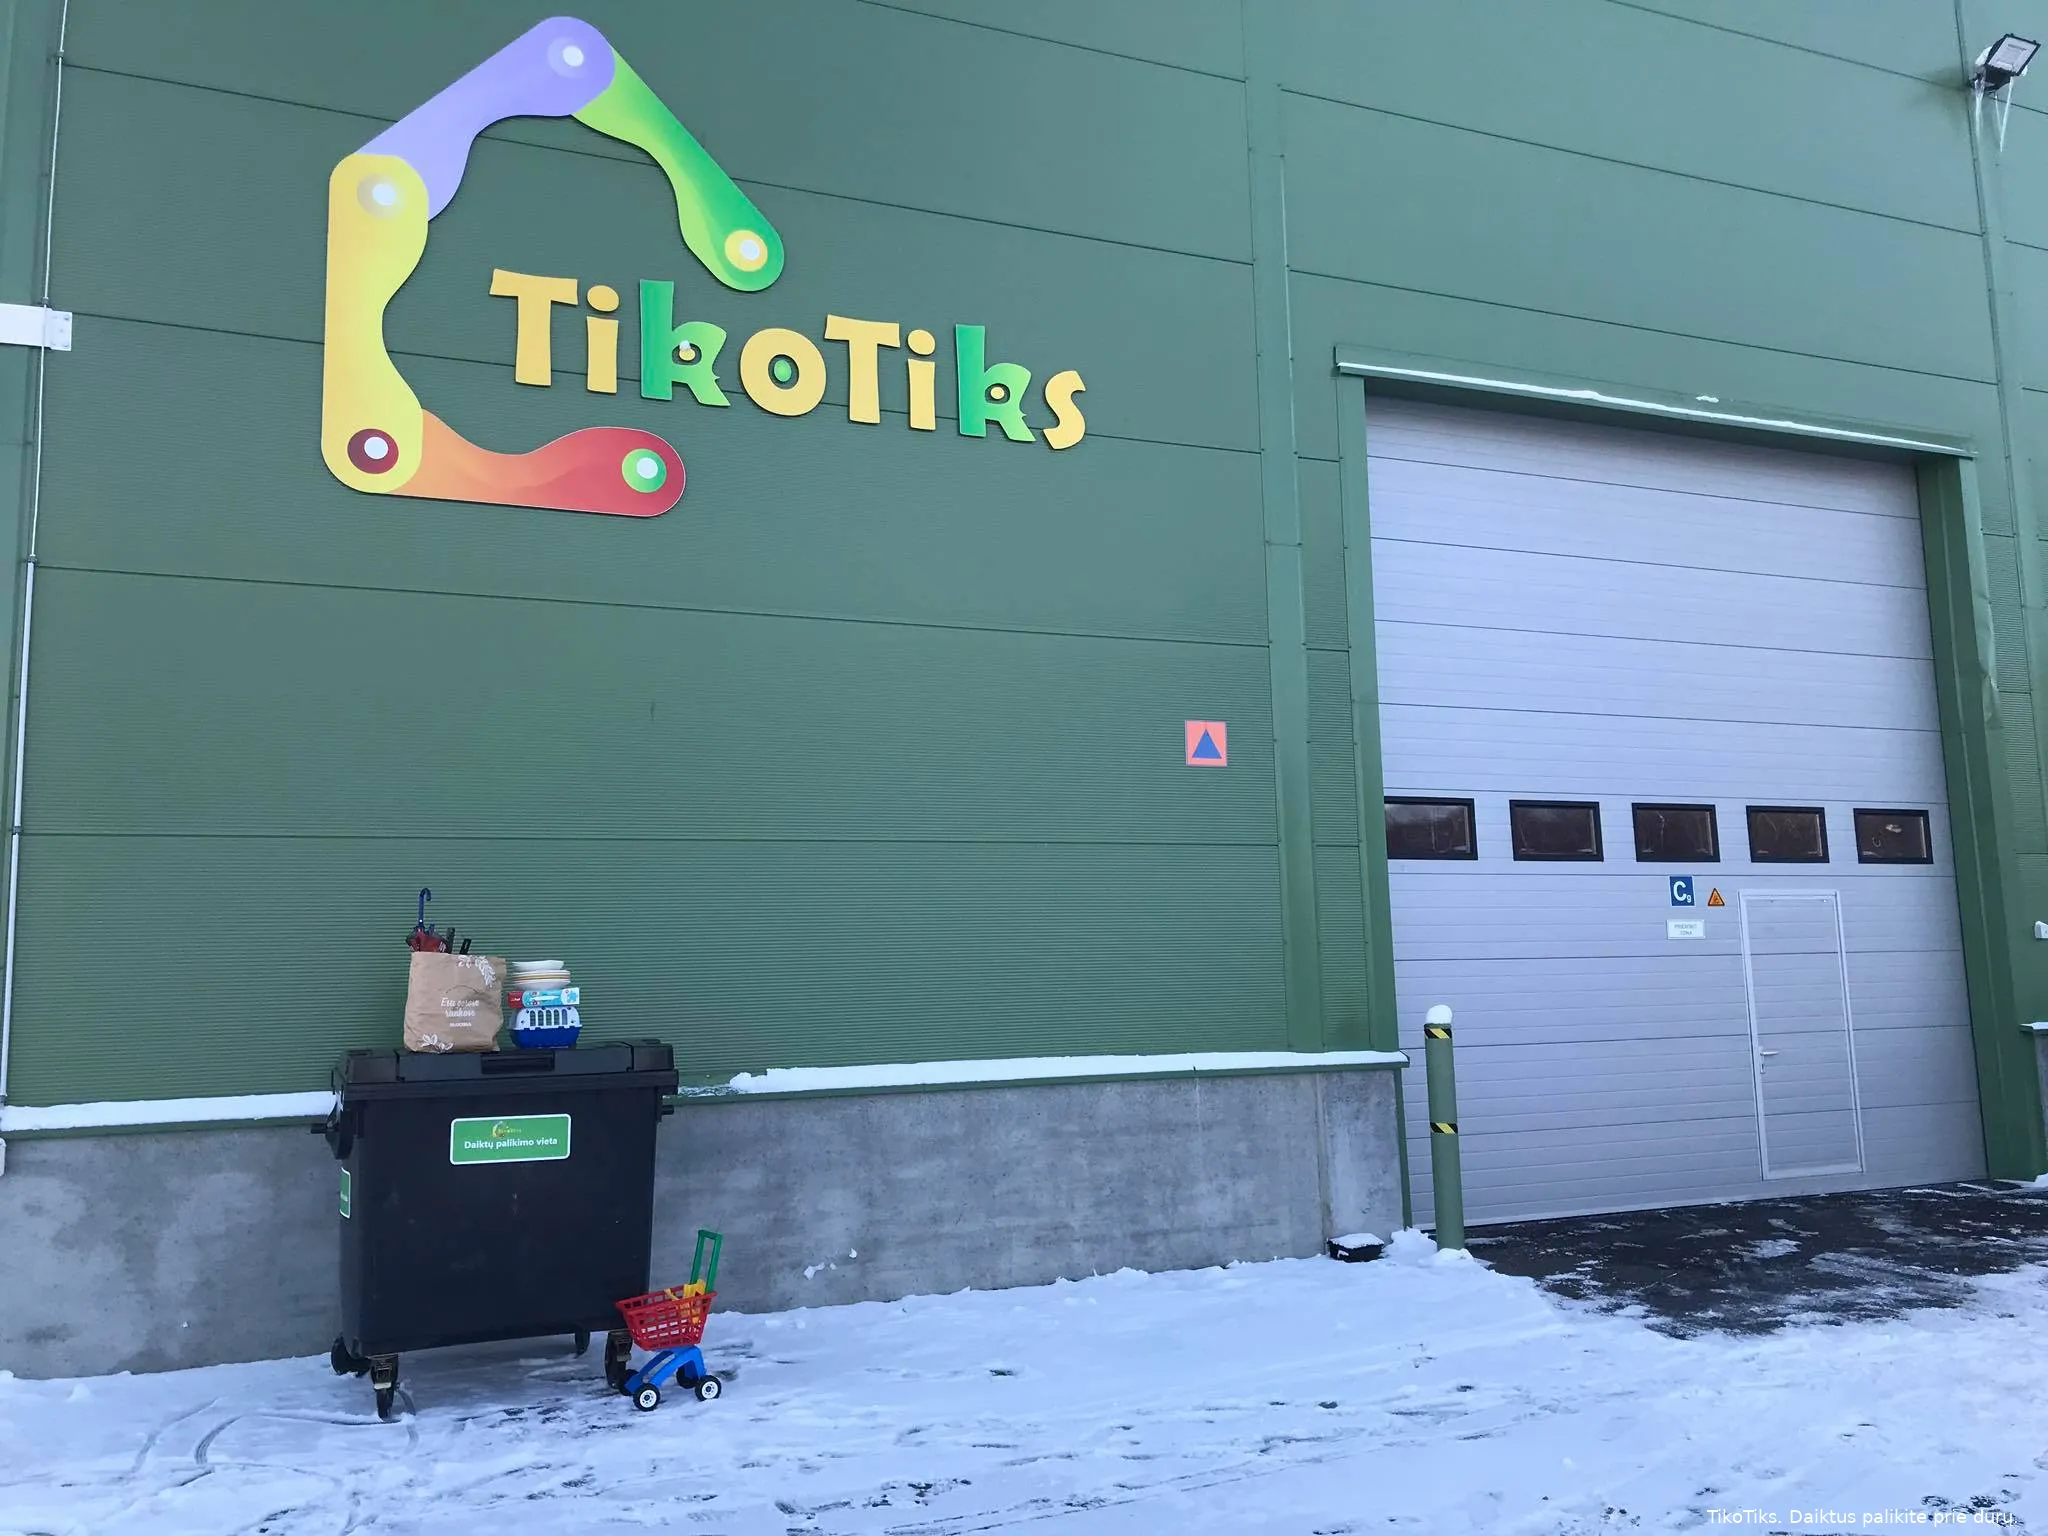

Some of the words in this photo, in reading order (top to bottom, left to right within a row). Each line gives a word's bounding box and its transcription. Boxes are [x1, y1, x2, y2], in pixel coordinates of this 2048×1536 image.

[489, 268, 1086, 450] TikoTiks
[464, 1140, 494, 1150] Daiktų
[496, 1138, 535, 1150] palikimo
[536, 1137, 558, 1146] vieta
